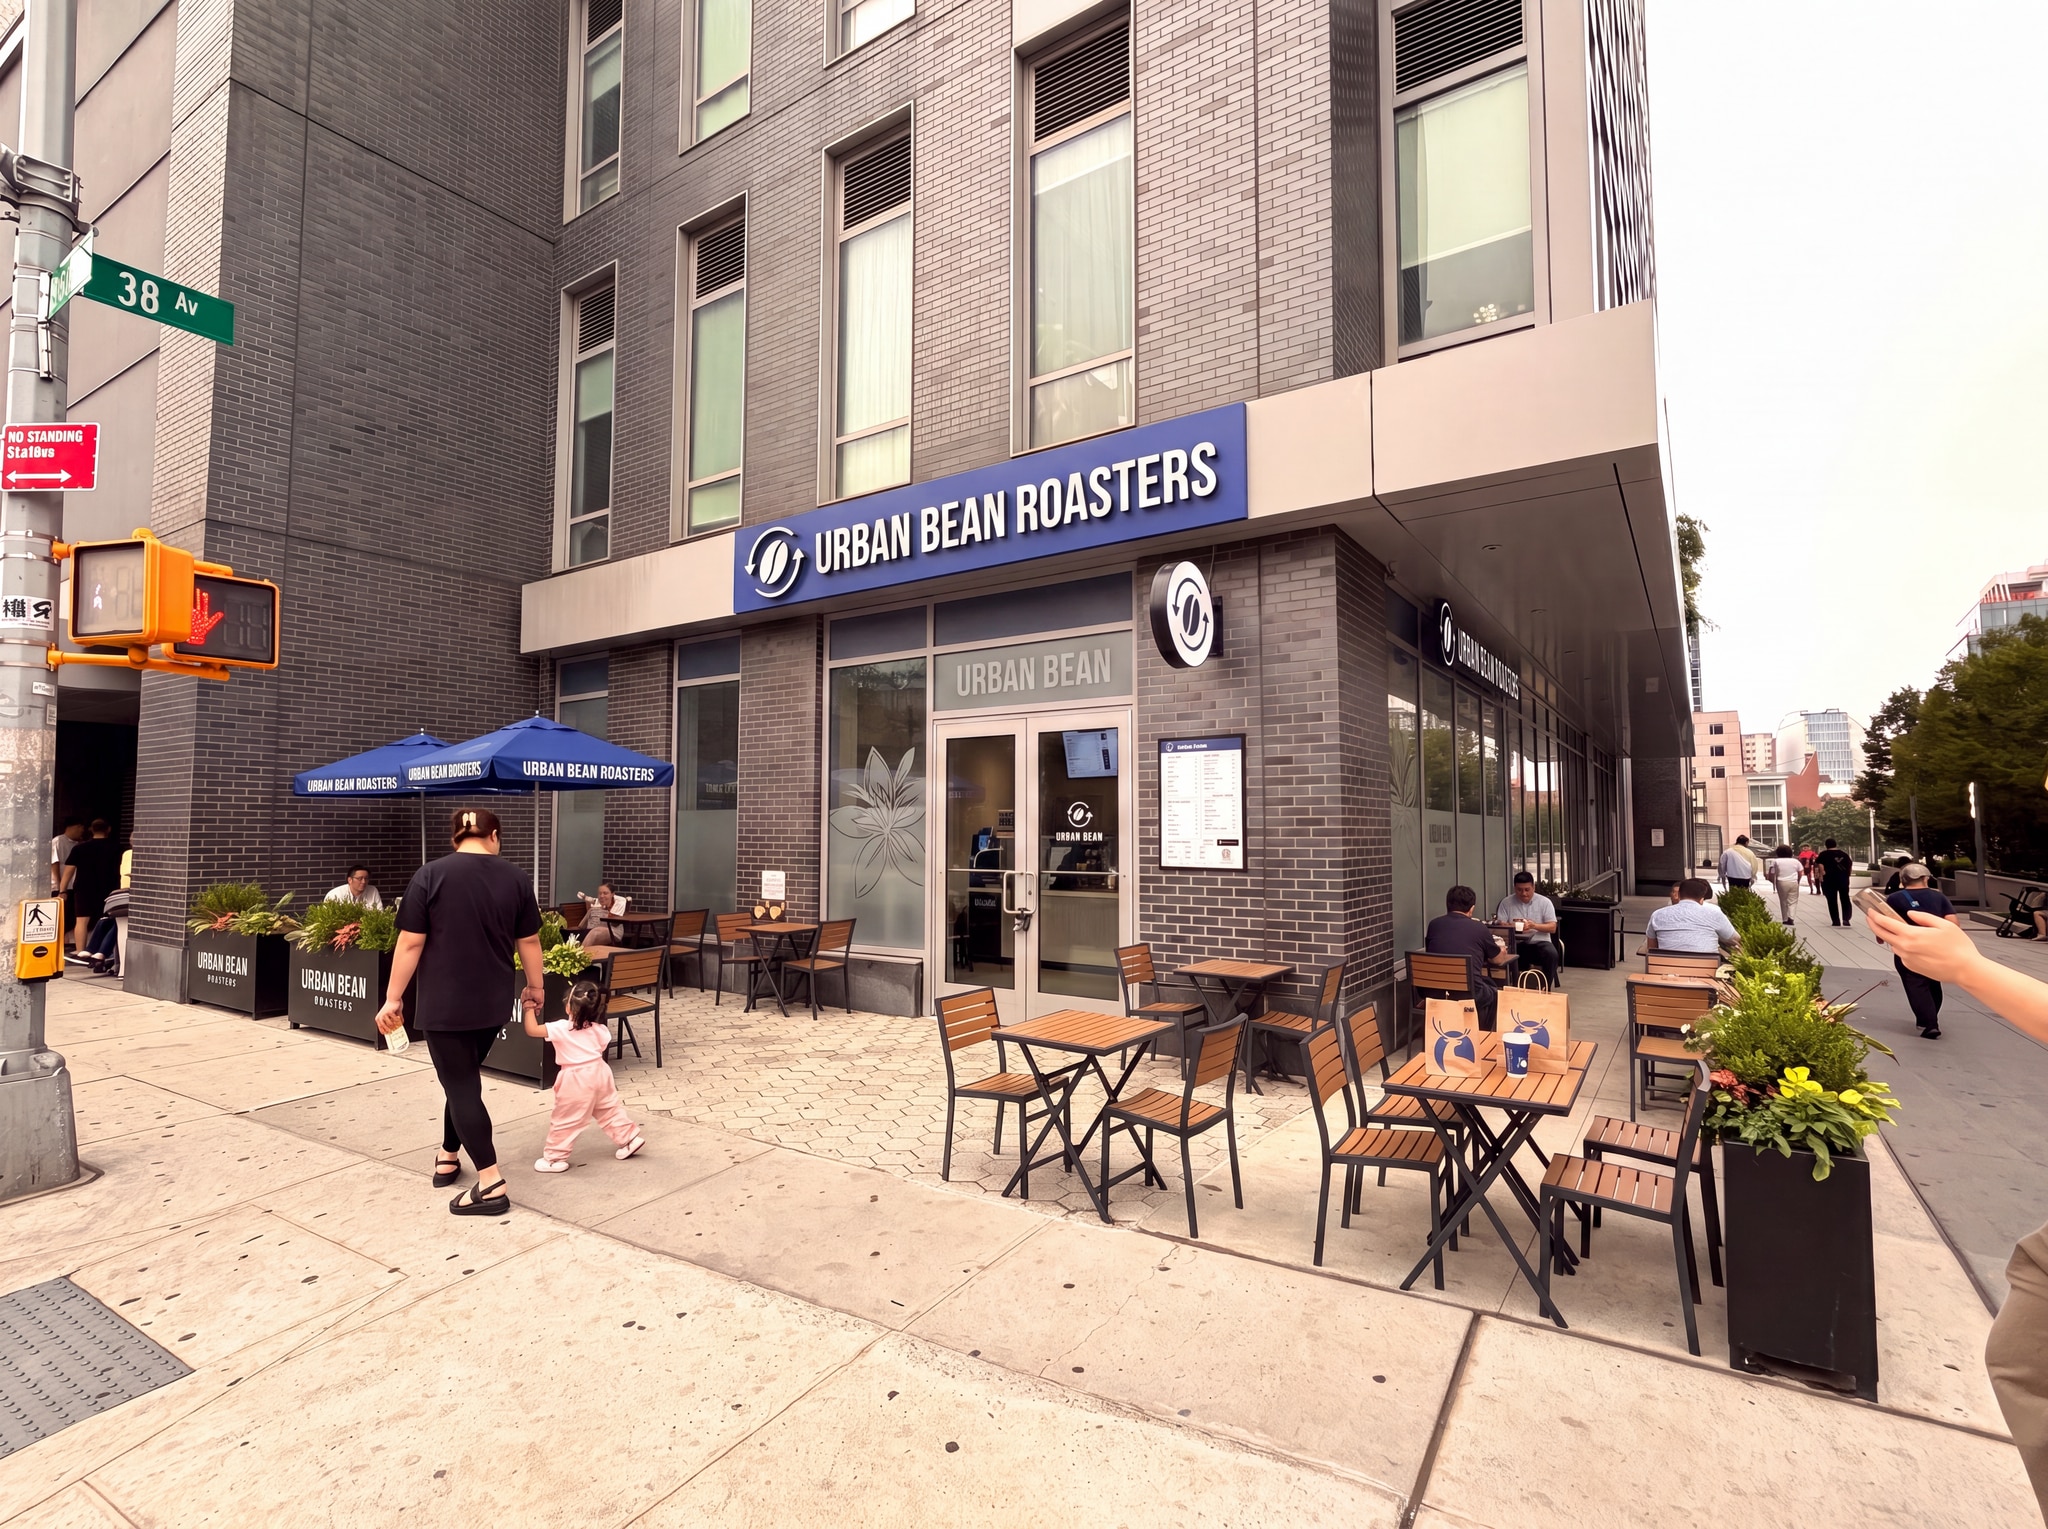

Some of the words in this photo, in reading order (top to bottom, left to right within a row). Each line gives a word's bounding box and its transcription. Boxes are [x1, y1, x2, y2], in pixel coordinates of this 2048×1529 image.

[117, 271, 159, 314] 38
[174, 291, 198, 316] Av
[8, 431, 24, 443] NO
[27, 430, 83, 443] STANDING
[815, 512, 911, 575] URBAN
[920, 490, 1005, 554] BEAN
[1016, 441, 1218, 535] ROASTERS
[957, 656, 1035, 697] URBAN
[1043, 648, 1111, 688] BEAN
[334, 778, 355, 791] BEAN
[356, 776, 398, 790] ROASTERS
[523, 760, 564, 777] URBAN
[567, 763, 598, 779] BEAN
[600, 765, 655, 782] ROASTERS
[1055, 831, 1080, 842] URBAN
[1082, 831, 1103, 842] BEAN
[197, 951, 224, 972] URBAN
[225, 955, 248, 976] BEAN
[301, 968, 335, 994] URBAN
[337, 973, 367, 999] BEAN
